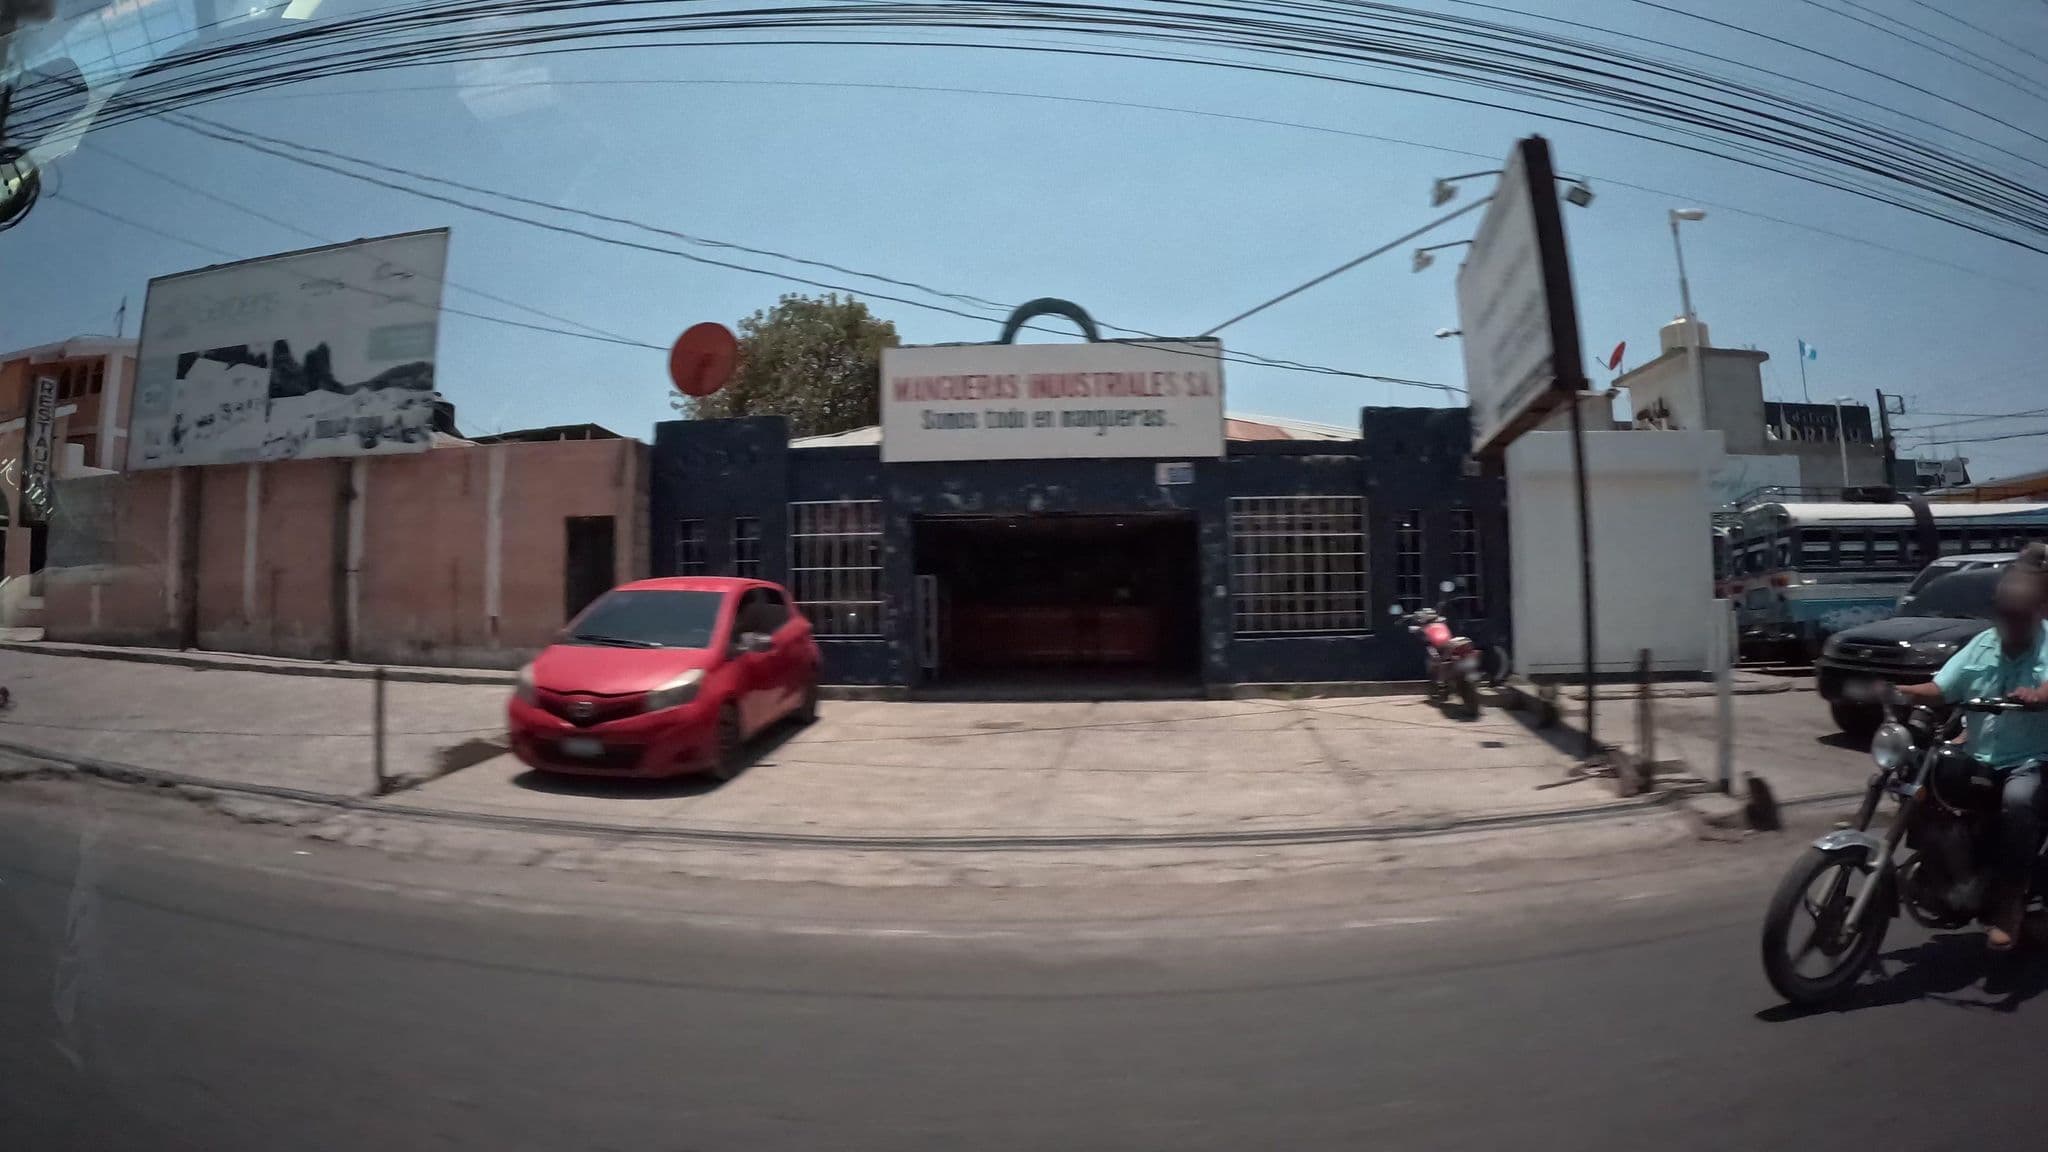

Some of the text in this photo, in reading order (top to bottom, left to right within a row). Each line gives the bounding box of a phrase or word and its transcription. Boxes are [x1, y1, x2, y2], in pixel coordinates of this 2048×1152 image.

[893, 375, 1019, 401] MANGUERAS
[922, 409, 977, 430] Somos
[986, 408, 1028, 429] todo
[1031, 411, 1055, 429] en
